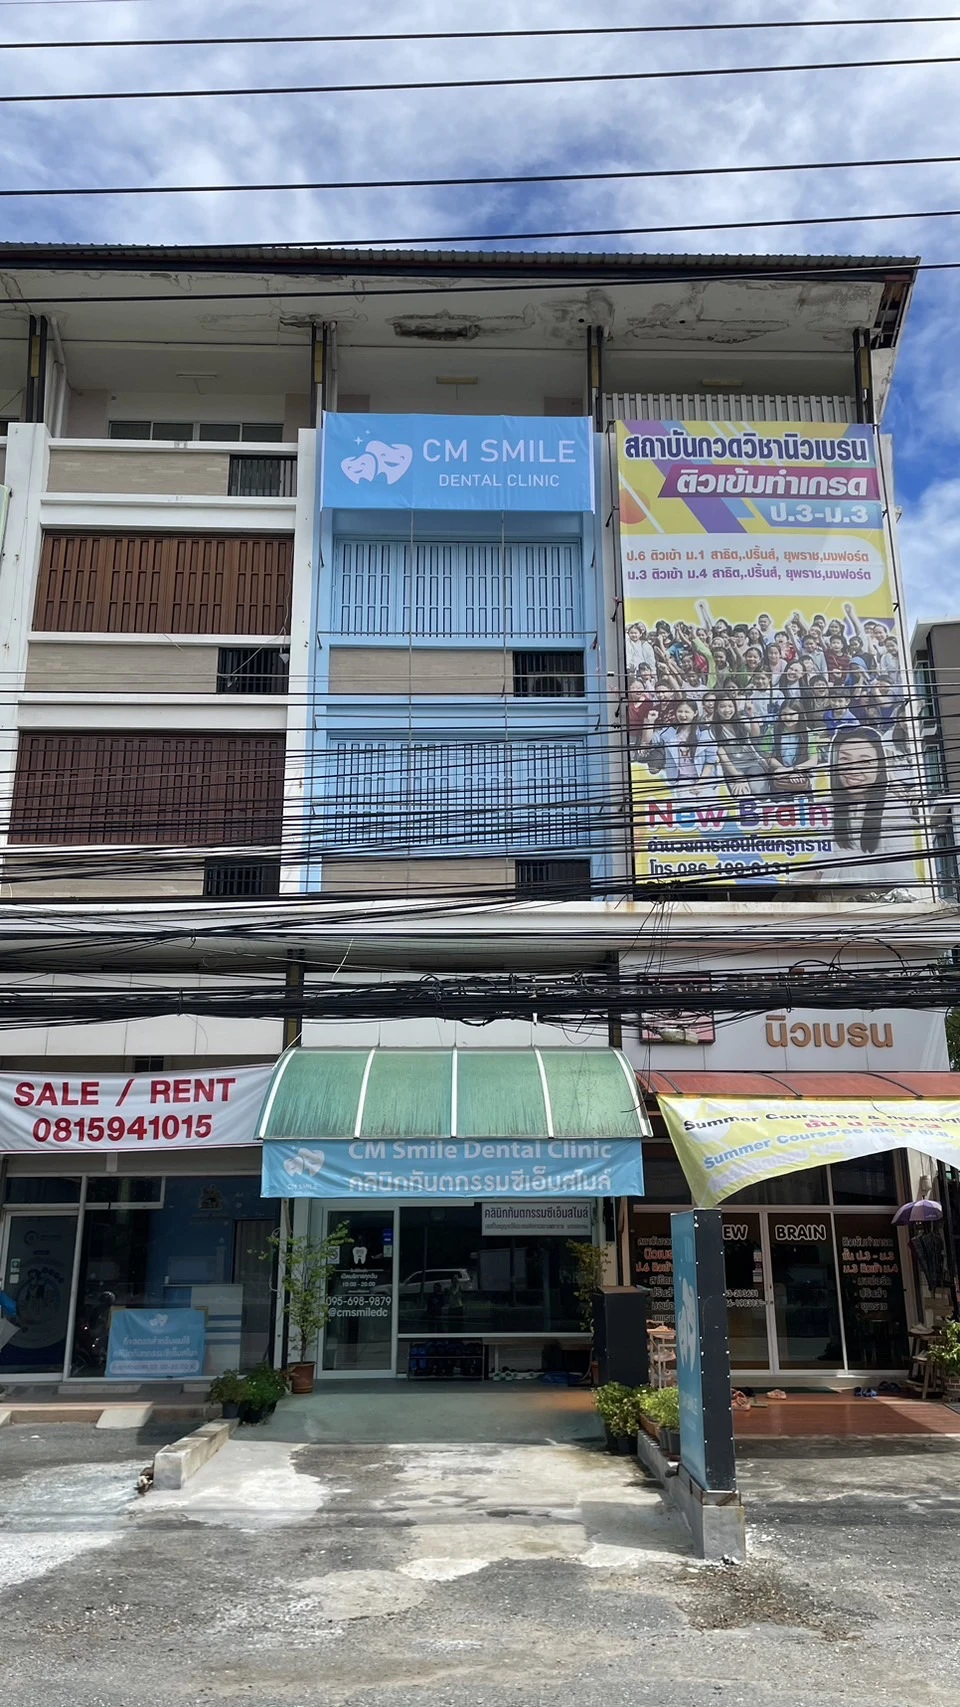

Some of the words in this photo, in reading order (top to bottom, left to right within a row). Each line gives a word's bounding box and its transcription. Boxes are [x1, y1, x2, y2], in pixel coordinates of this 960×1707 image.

[423, 438, 468, 463] CM
[480, 439, 576, 464] SMILE
[624, 430, 868, 461] สถาบันกวดวิชานิวเบรน
[439, 474, 501, 487] DENTAL
[507, 474, 560, 488] CLINIC
[676, 468, 868, 496] ติวเข้มทำเกรด
[770, 502, 868, 523] ป.3-ม.3
[626, 550, 646, 561] ป.6
[650, 548, 682, 560] ติวเข้า
[686, 550, 704, 560] ม.1
[628, 570, 647, 580] ม.3
[652, 567, 683, 580] ติวเข้า
[688, 568, 708, 579] ม.4
[648, 801, 725, 828] New
[739, 797, 829, 828] Brain
[766, 1014, 894, 1048] นิวเบรน
[13, 1082, 100, 1107] SALE
[115, 1078, 134, 1107] /
[150, 1078, 236, 1104] RENT
[32, 1114, 213, 1143] 0815941015
[684, 1115, 759, 1132] Summer
[348, 1142, 386, 1160] CM
[393, 1140, 457, 1160] Smile
[464, 1140, 542, 1160] Dental
[548, 1140, 612, 1160] Clinic
[704, 1139, 771, 1170] Summer
[722, 1224, 748, 1241] EW
[775, 1224, 827, 1242] BRAIN
[326, 1296, 392, 1306] 095-698-9879
[328, 1308, 388, 1317] @cmsmiledc
